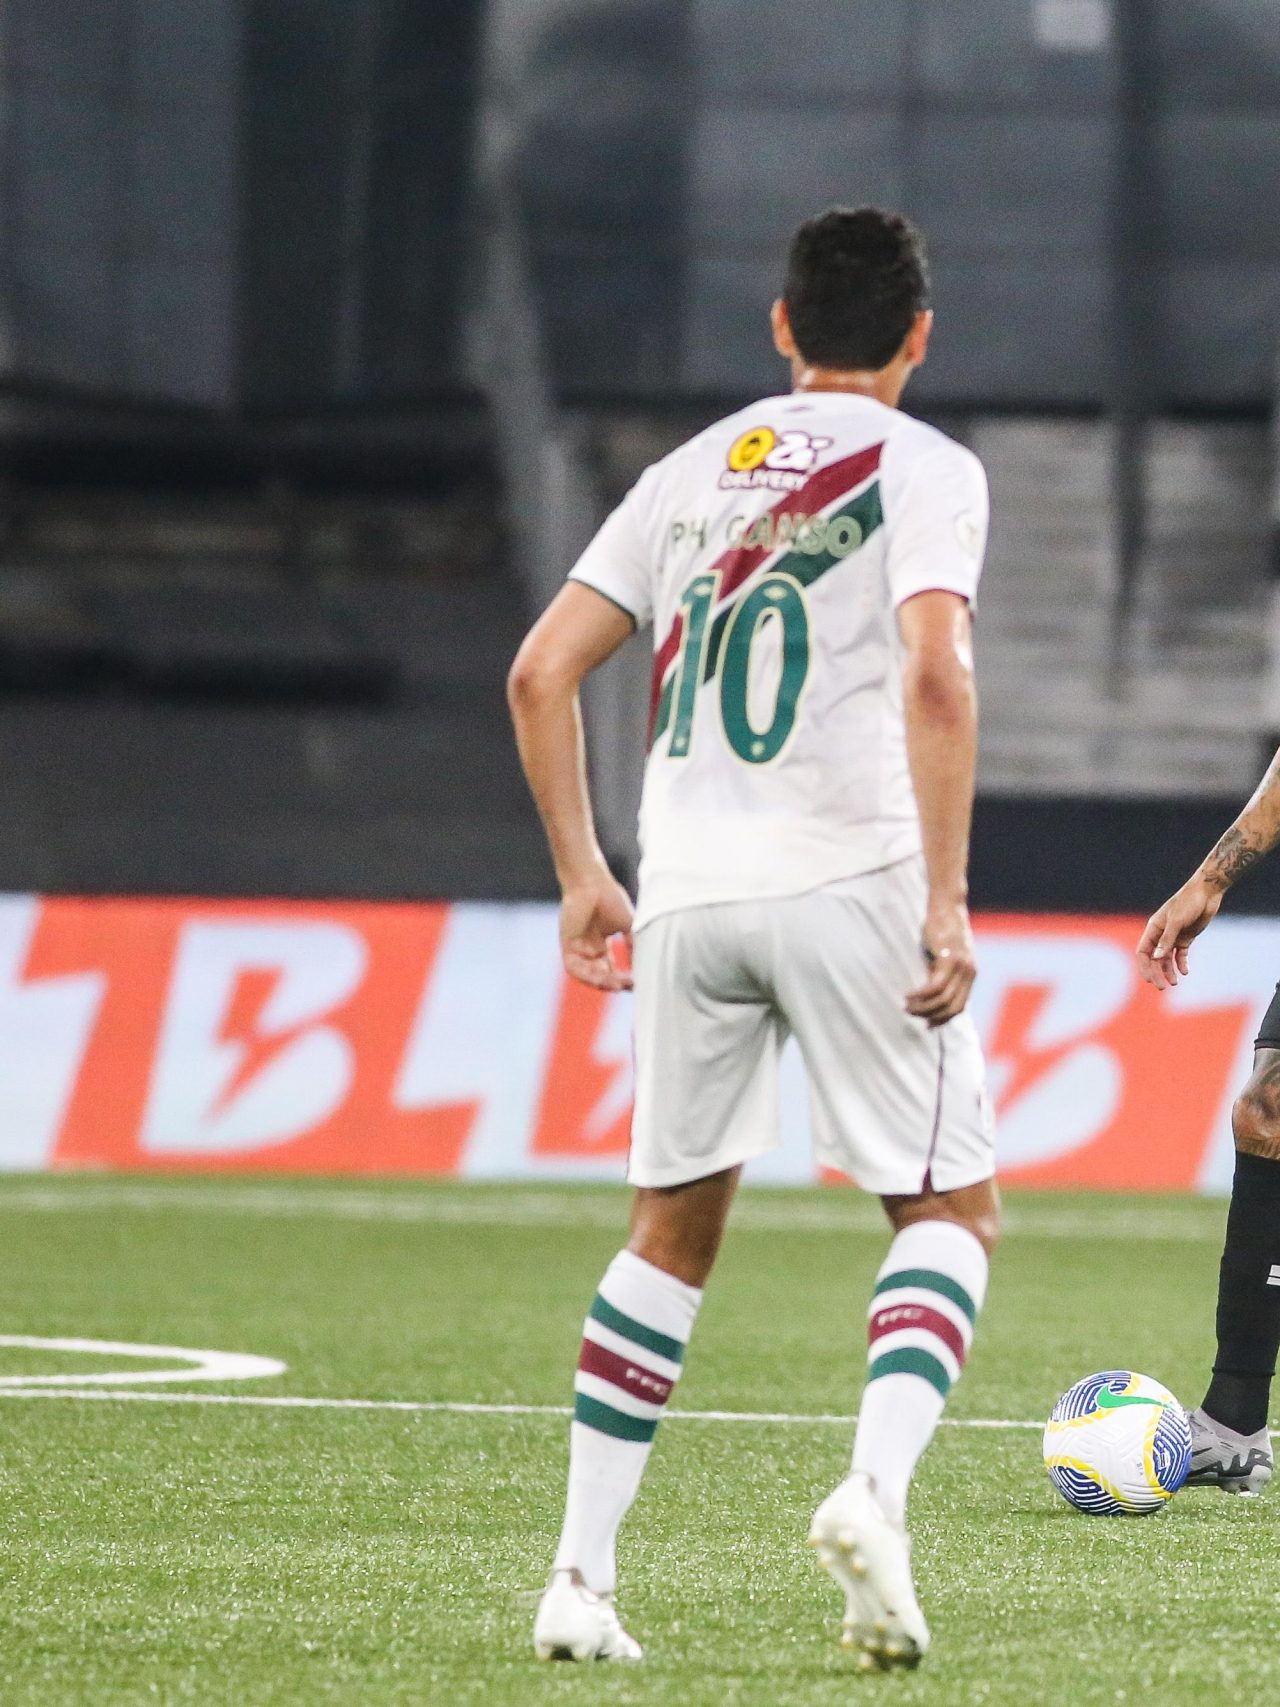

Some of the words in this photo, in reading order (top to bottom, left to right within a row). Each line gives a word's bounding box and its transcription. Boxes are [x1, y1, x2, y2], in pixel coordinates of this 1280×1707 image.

[670, 517, 708, 550] PH
[725, 511, 863, 559] GANSO
[665, 569, 814, 768] 10
